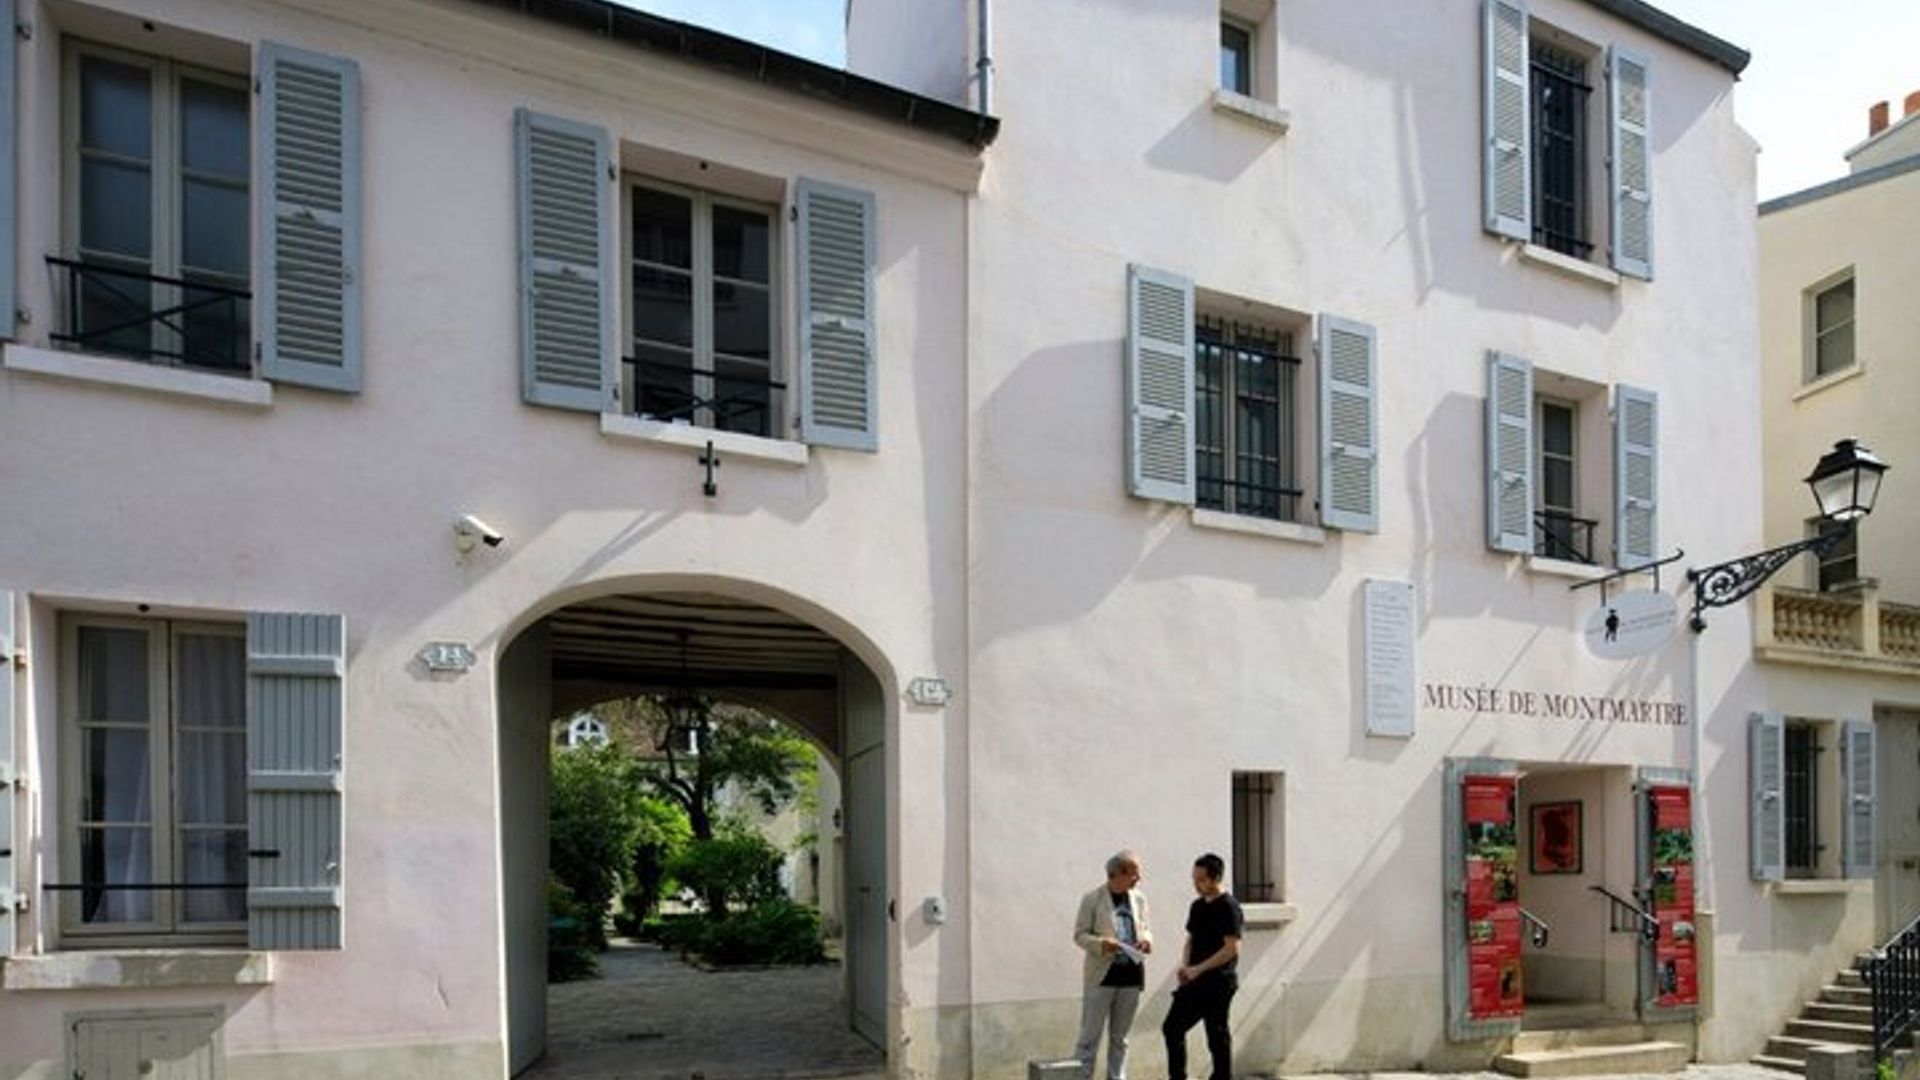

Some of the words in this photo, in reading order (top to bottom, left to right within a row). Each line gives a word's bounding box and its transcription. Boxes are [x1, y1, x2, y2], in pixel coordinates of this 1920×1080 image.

[1423, 682, 1502, 713] MUSÉE
[1508, 690, 1535, 716] DE
[1542, 693, 1688, 726] MONTMARTRE
